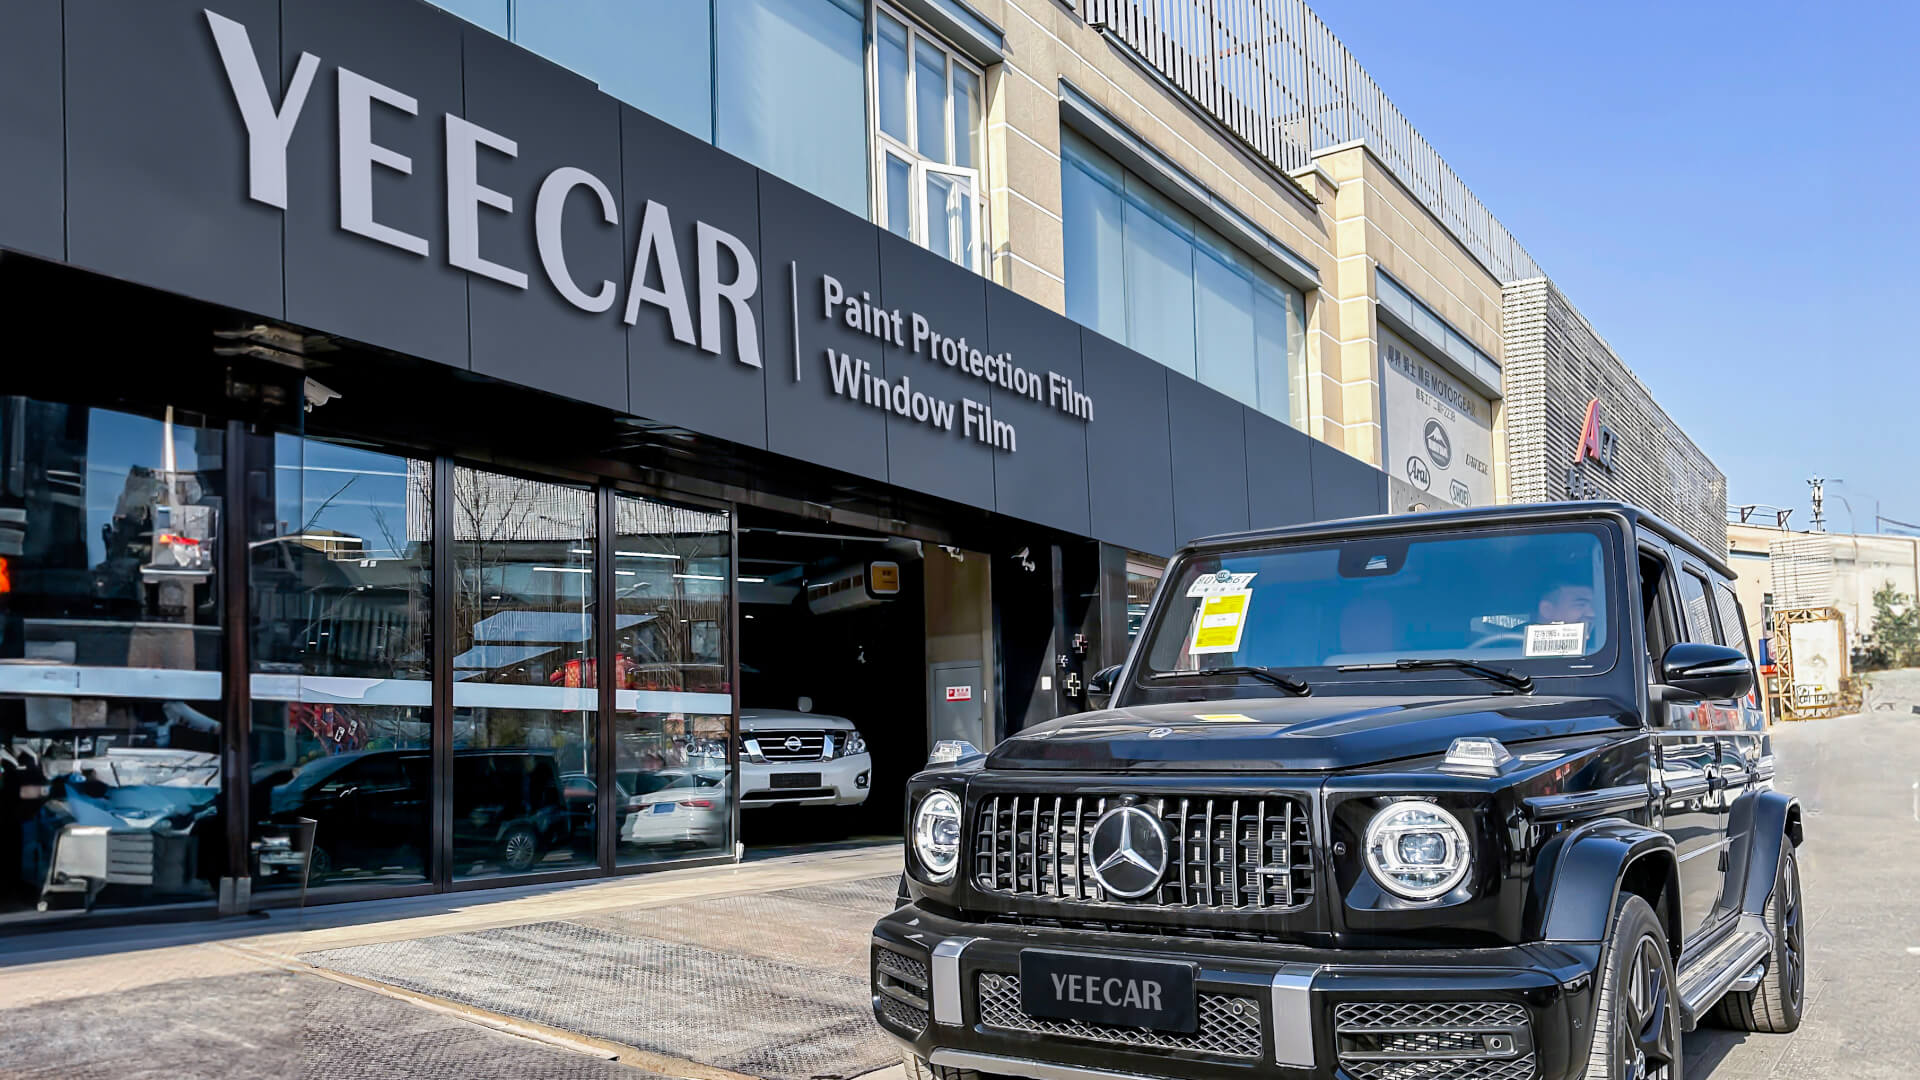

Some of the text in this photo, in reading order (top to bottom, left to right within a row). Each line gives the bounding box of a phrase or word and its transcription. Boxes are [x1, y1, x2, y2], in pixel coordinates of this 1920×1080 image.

[204, 9, 763, 369] YEECAR
[823, 274, 1094, 422] Paint Protection Film
[827, 348, 1017, 452] Window Film
[1431, 375, 1476, 417] MOTORGEAR
[1409, 459, 1428, 484] Arai
[1452, 484, 1469, 506] SHOEI
[1051, 973, 1162, 1011] YEECAR
